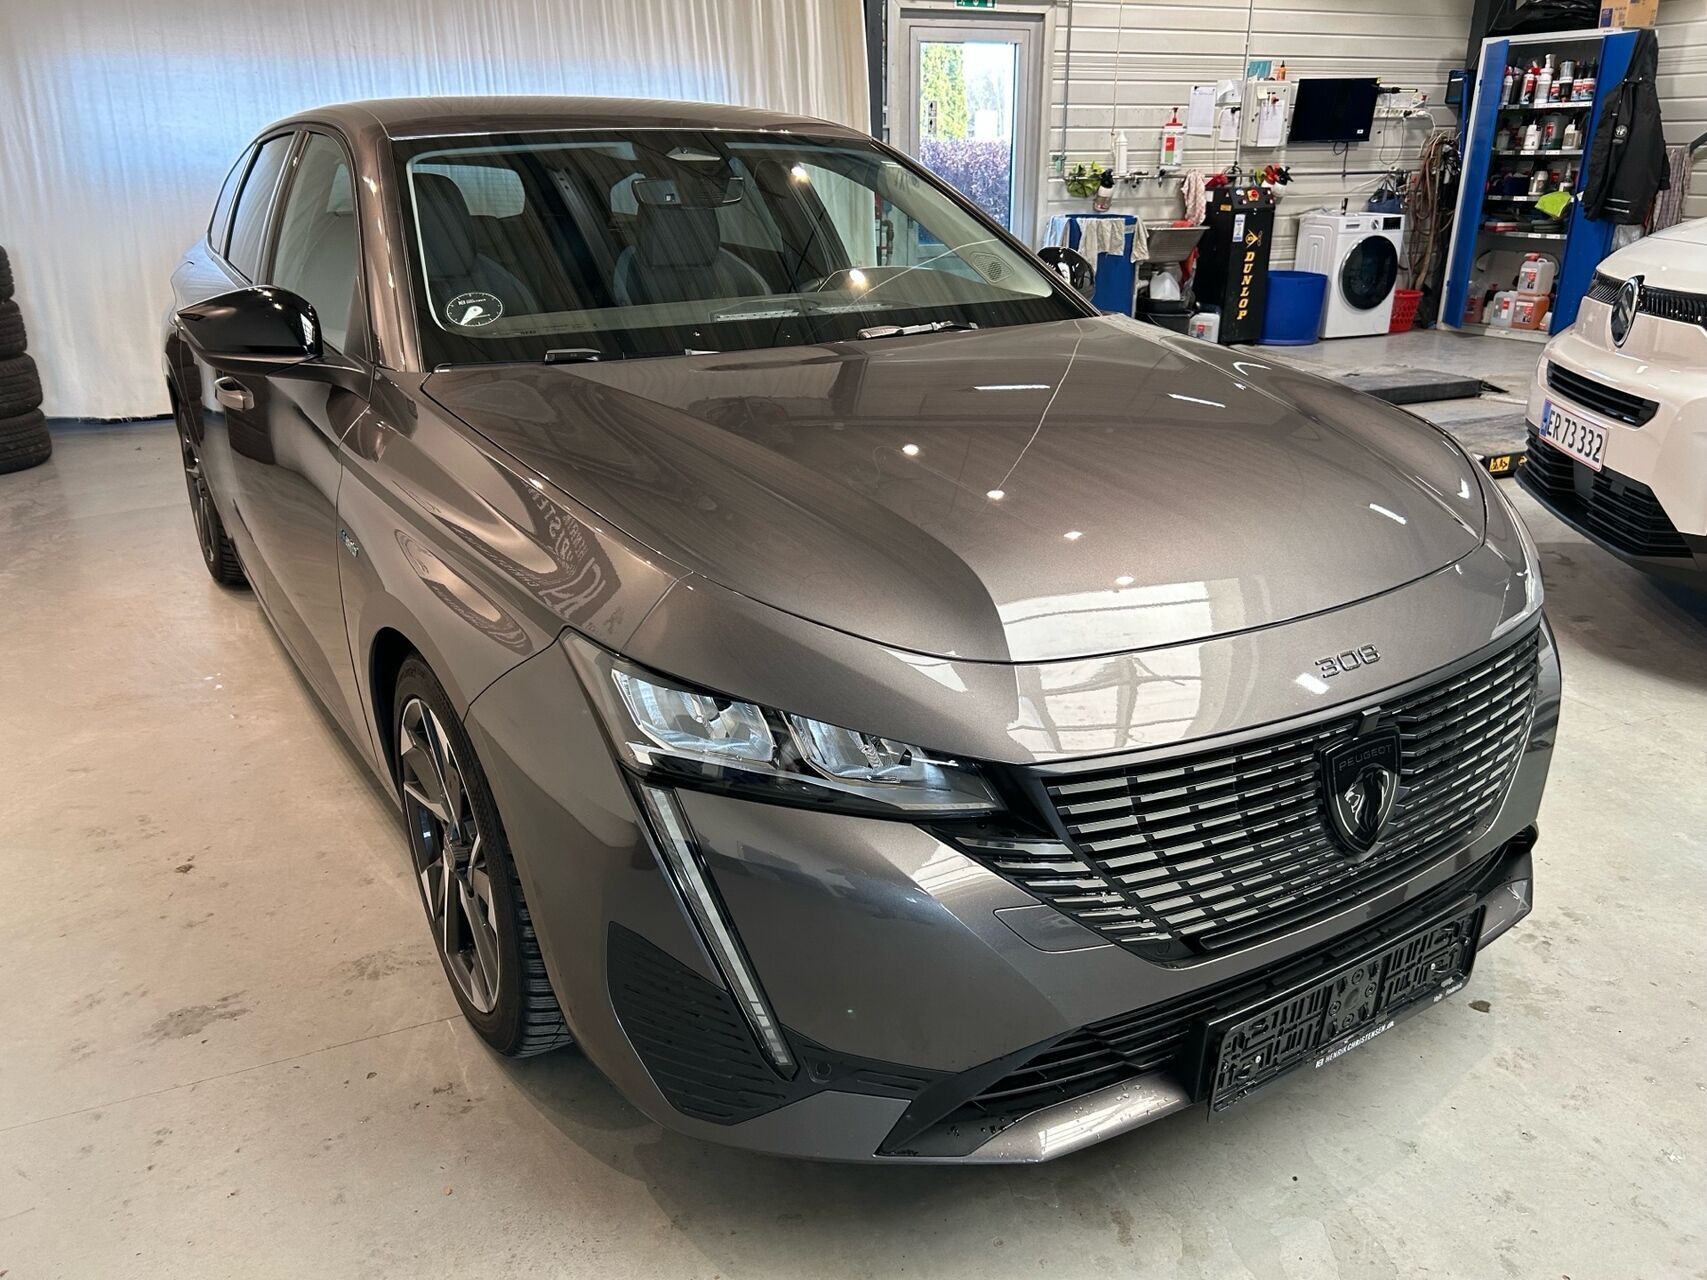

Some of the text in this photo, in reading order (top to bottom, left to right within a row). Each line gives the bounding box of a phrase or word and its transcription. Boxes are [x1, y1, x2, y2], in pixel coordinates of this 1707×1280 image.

[1236, 251, 1256, 321] DUNLOP
[1546, 410, 1604, 463] ER 73 332
[1314, 643, 1382, 679] 308
[1338, 743, 1393, 772] PEUGEOT
